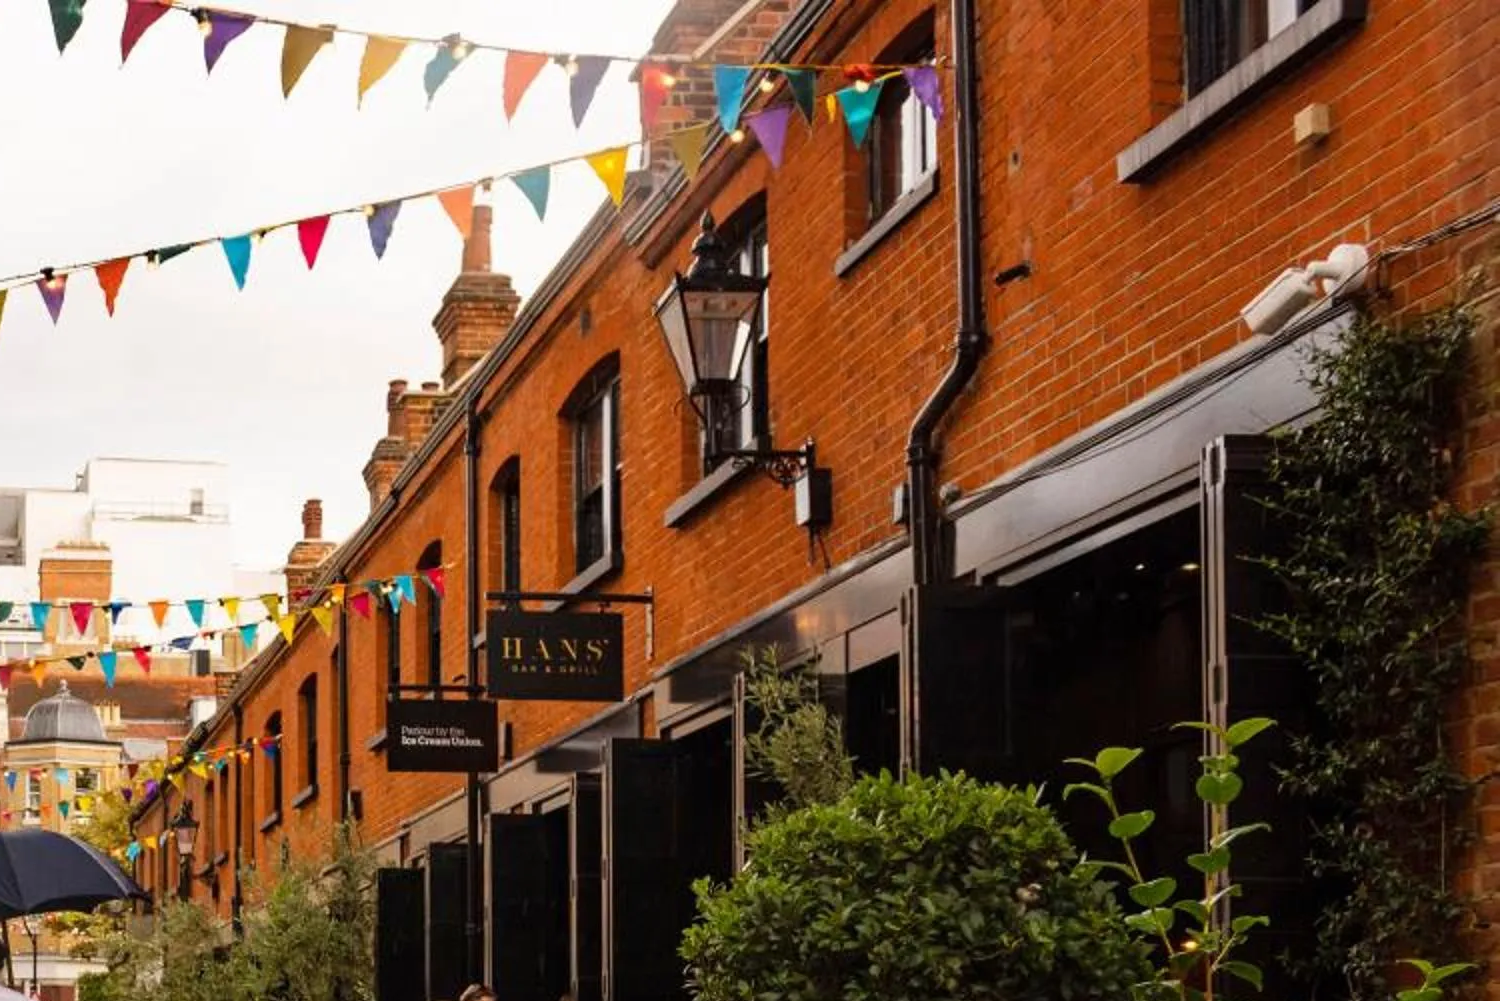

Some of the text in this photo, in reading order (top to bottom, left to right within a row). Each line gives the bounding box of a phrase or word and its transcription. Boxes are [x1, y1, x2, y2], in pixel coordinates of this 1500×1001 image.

[511, 664, 598, 674] BAR & GRILL
[401, 735, 416, 745] Ice
[417, 735, 450, 746] Cream
